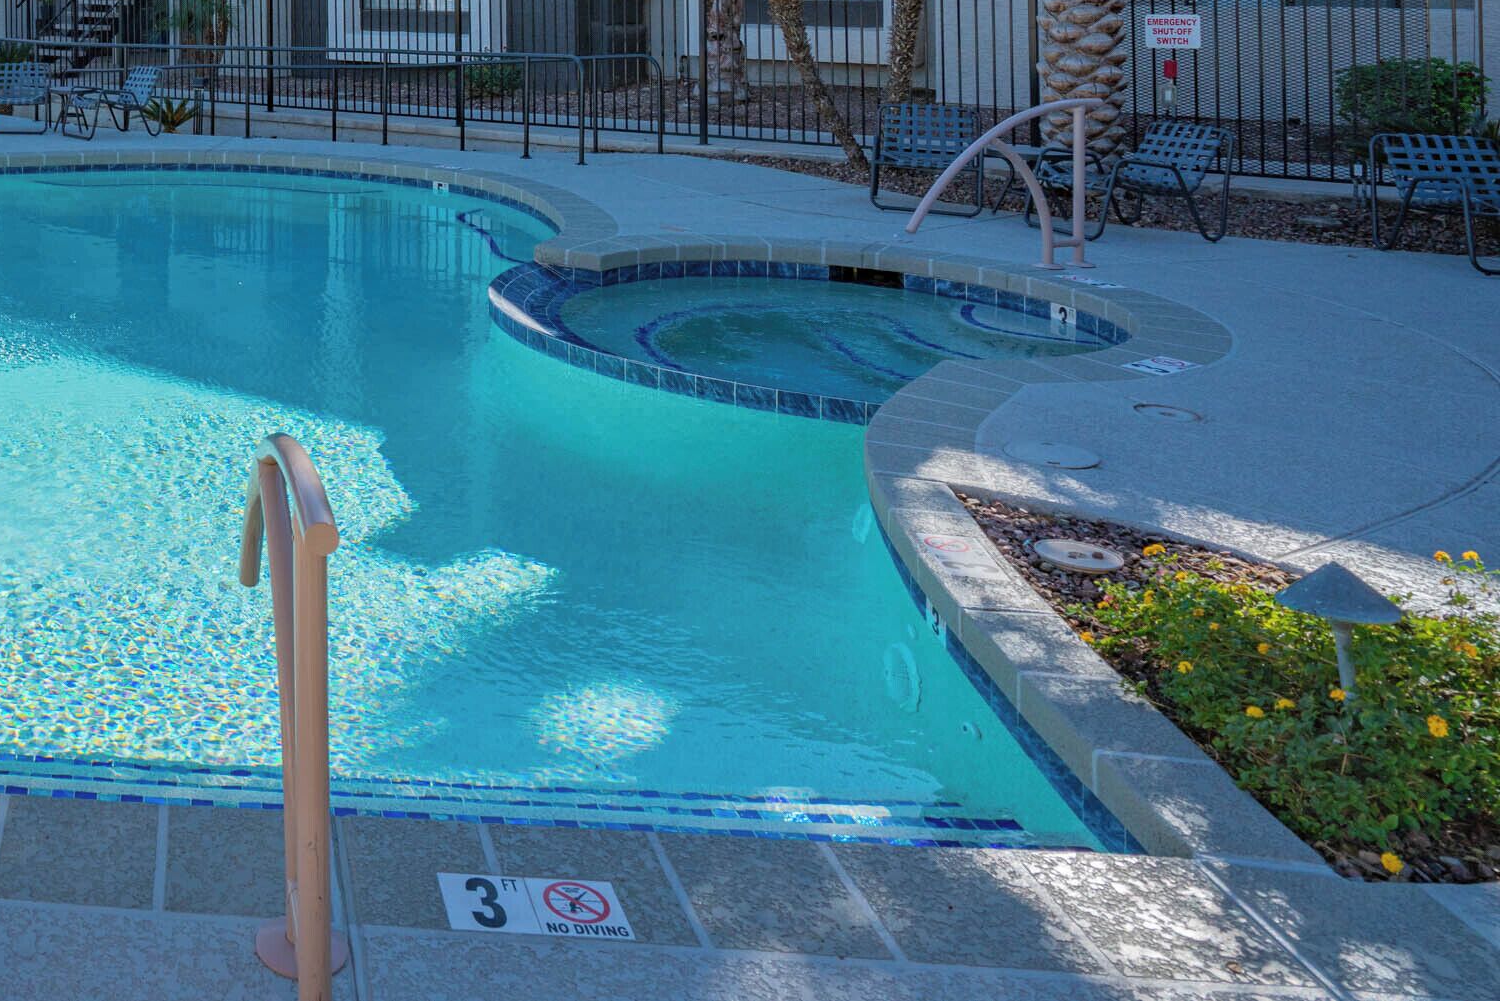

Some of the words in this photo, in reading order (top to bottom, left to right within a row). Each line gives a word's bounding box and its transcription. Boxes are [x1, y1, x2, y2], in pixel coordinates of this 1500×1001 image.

[1147, 18, 1197, 26] EMERGENCY
[1152, 27, 1193, 35] SHUT-OFF
[1156, 37, 1189, 45] SWITCH
[465, 877, 508, 929] 3
[501, 879, 518, 892] FT
[546, 922, 570, 935] NO
[575, 923, 630, 938] DIVING
